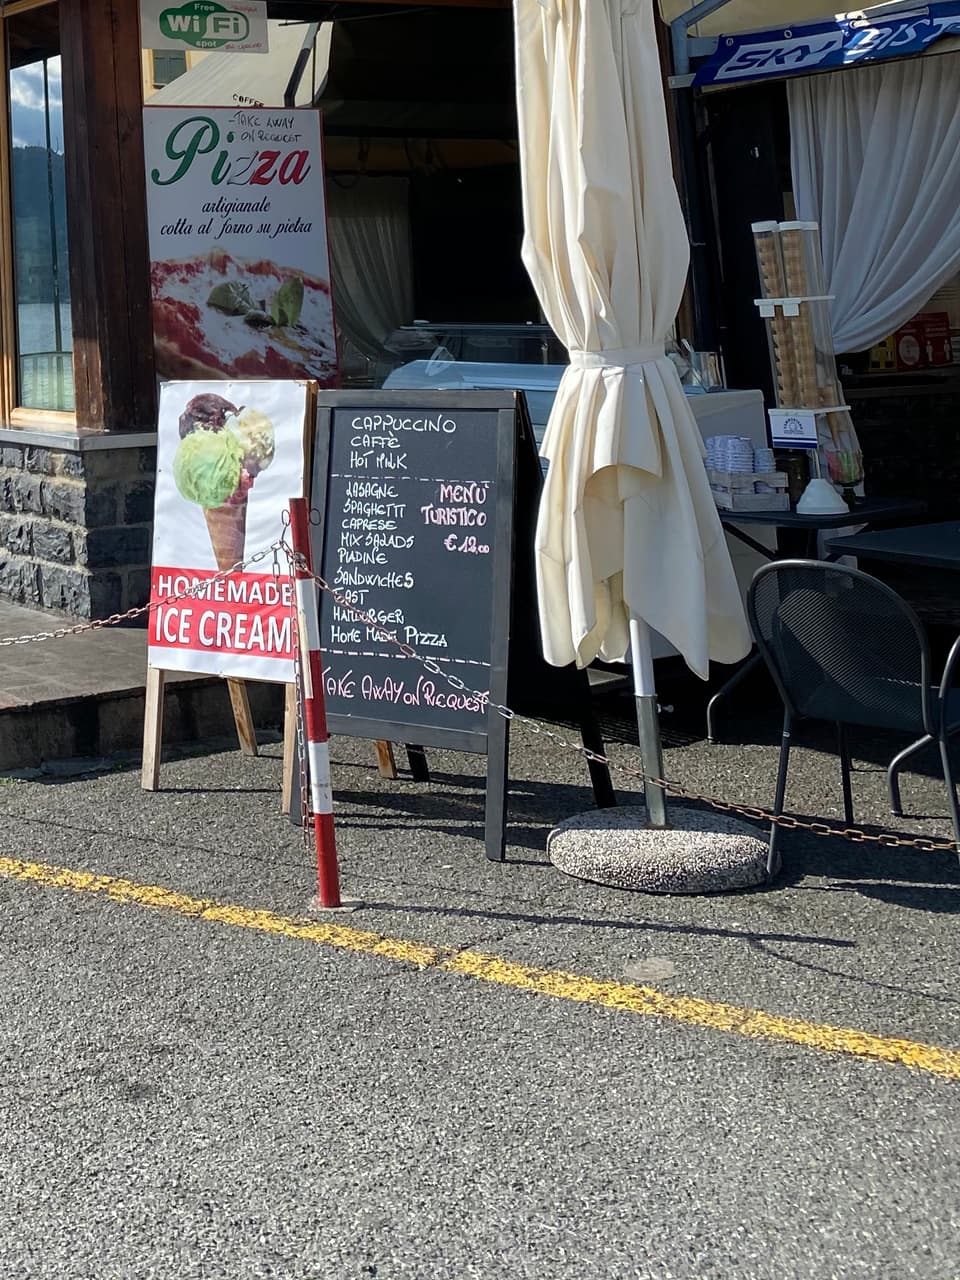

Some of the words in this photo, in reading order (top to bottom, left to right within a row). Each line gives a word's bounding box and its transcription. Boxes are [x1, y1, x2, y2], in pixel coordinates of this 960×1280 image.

[194, 3, 215, 12] Free
[195, 40, 217, 49] spot
[724, 40, 838, 72] SKY
[266, 117, 295, 129] AWAY
[151, 115, 312, 186] Pizza
[201, 195, 271, 218] artigianale
[160, 218, 193, 236] cotta
[197, 217, 214, 234] al
[214, 218, 253, 240] forno
[256, 223, 272, 234] su
[269, 216, 313, 239] pietra
[351, 414, 457, 433] CAPPUCCINO
[350, 430, 401, 449] CAFFÈ
[350, 450, 374, 469] HOT
[376, 452, 408, 469] MILK
[346, 480, 399, 499] LASAGNE
[343, 498, 407, 519] SPAGHETTI
[420, 503, 487, 527] TURISTICO
[341, 518, 398, 531] CAPRESE
[341, 531, 363, 548] MIX
[365, 532, 415, 549] SALADS
[337, 547, 389, 565] PIADINE
[334, 566, 415, 589] SANDWICHES
[158, 574, 293, 607] HOMEMADE
[155, 606, 193, 644] ICE
[198, 610, 291, 654] CREAM
[404, 625, 448, 647] PIZZA
[321, 666, 356, 699] TAKE
[361, 674, 405, 704] AWAY
[403, 675, 425, 706] ON
[422, 680, 490, 715] REQUEST
